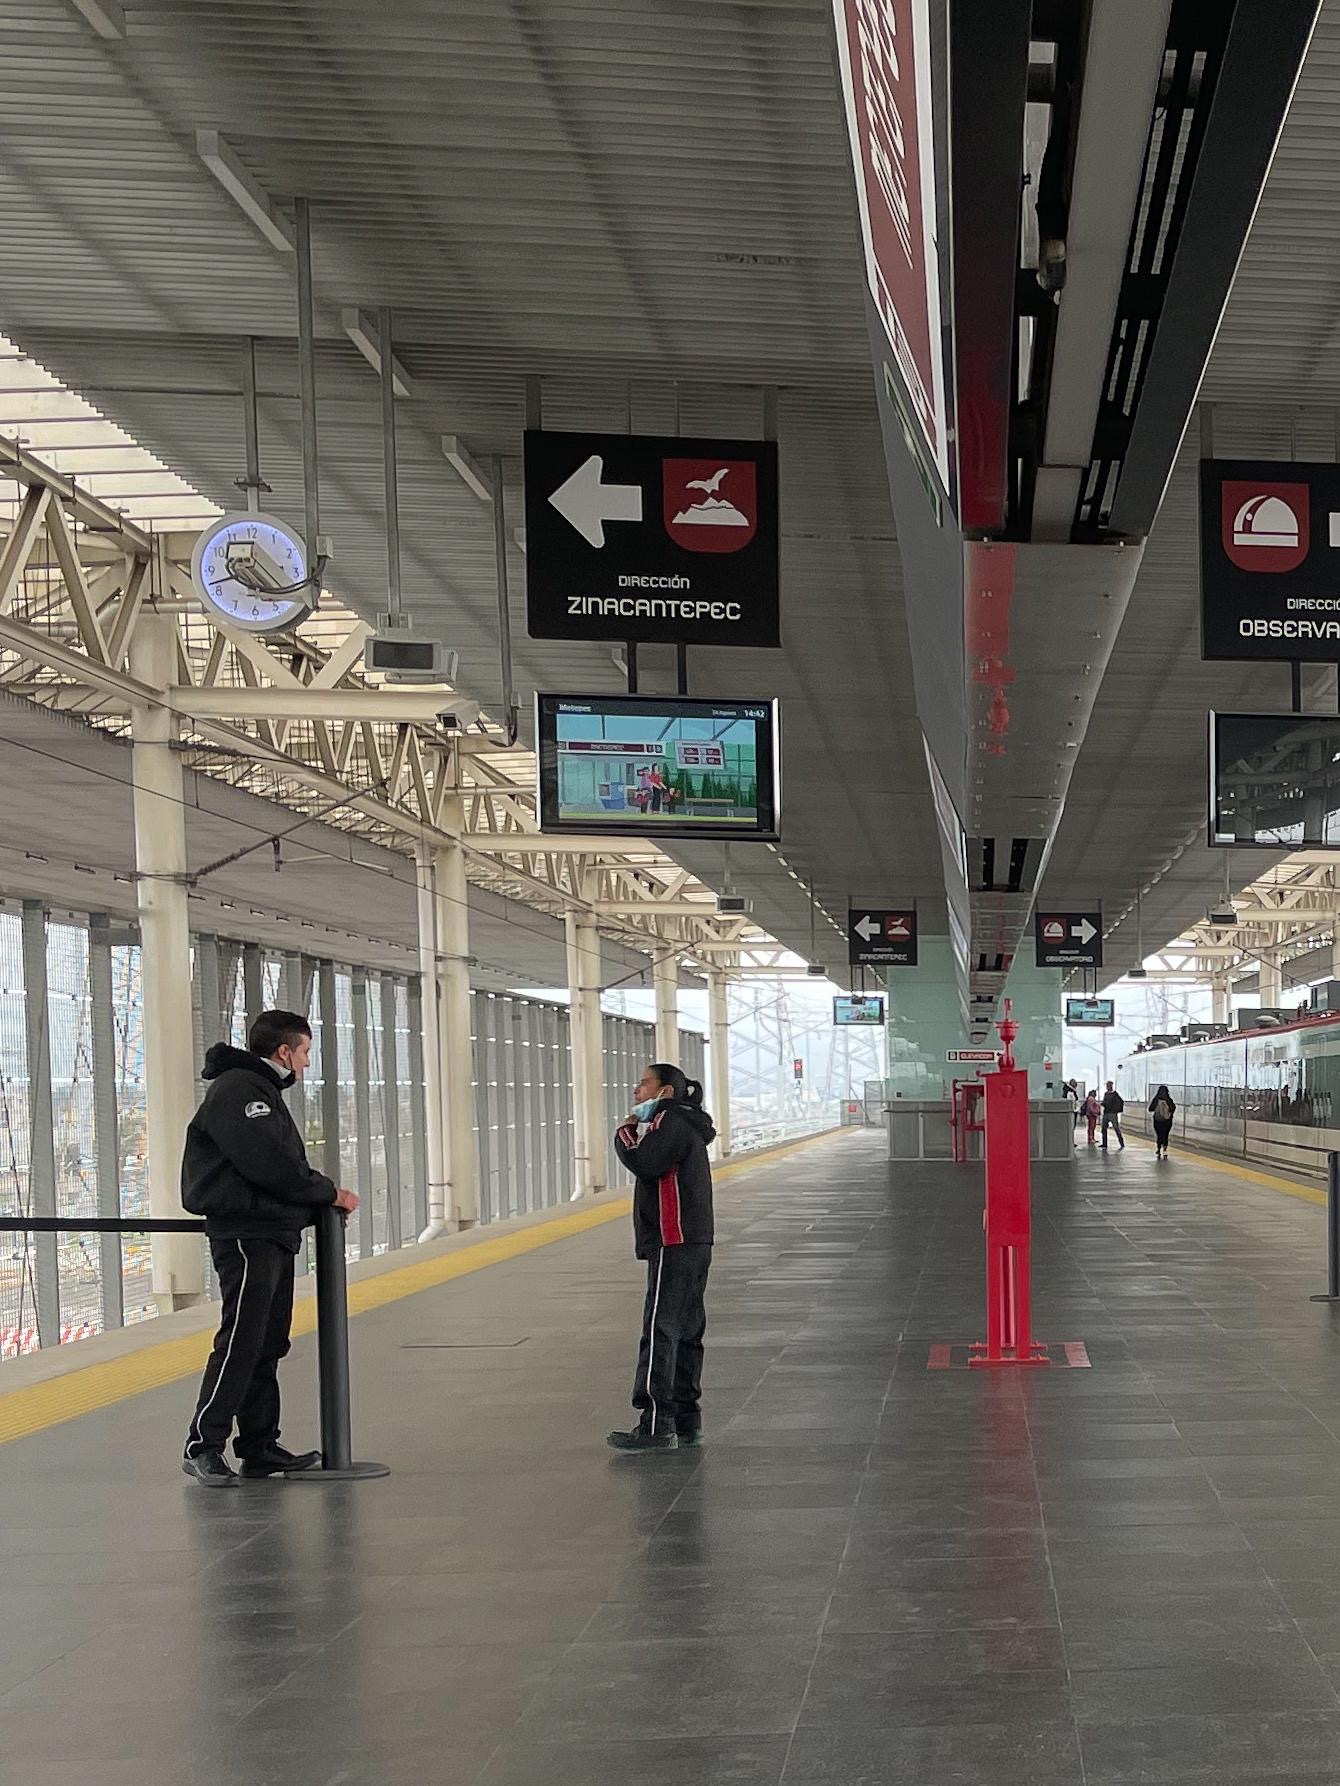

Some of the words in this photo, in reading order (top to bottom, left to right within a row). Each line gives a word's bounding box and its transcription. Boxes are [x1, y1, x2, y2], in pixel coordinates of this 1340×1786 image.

[857, 0, 914, 270] METEPE
[247, 527, 258, 539] 12
[272, 534, 277, 544] 1
[214, 547, 225, 558] 10
[286, 548, 293, 559] 2
[208, 565, 216, 576] 9
[293, 567, 300, 578] 3
[618, 574, 690, 589] DIRECCIÓN
[215, 586, 223, 596] 8
[232, 600, 239, 610] 7
[252, 605, 260, 616] 6
[273, 601, 280, 612] 5
[567, 596, 741, 620] ZINACANTEPEC
